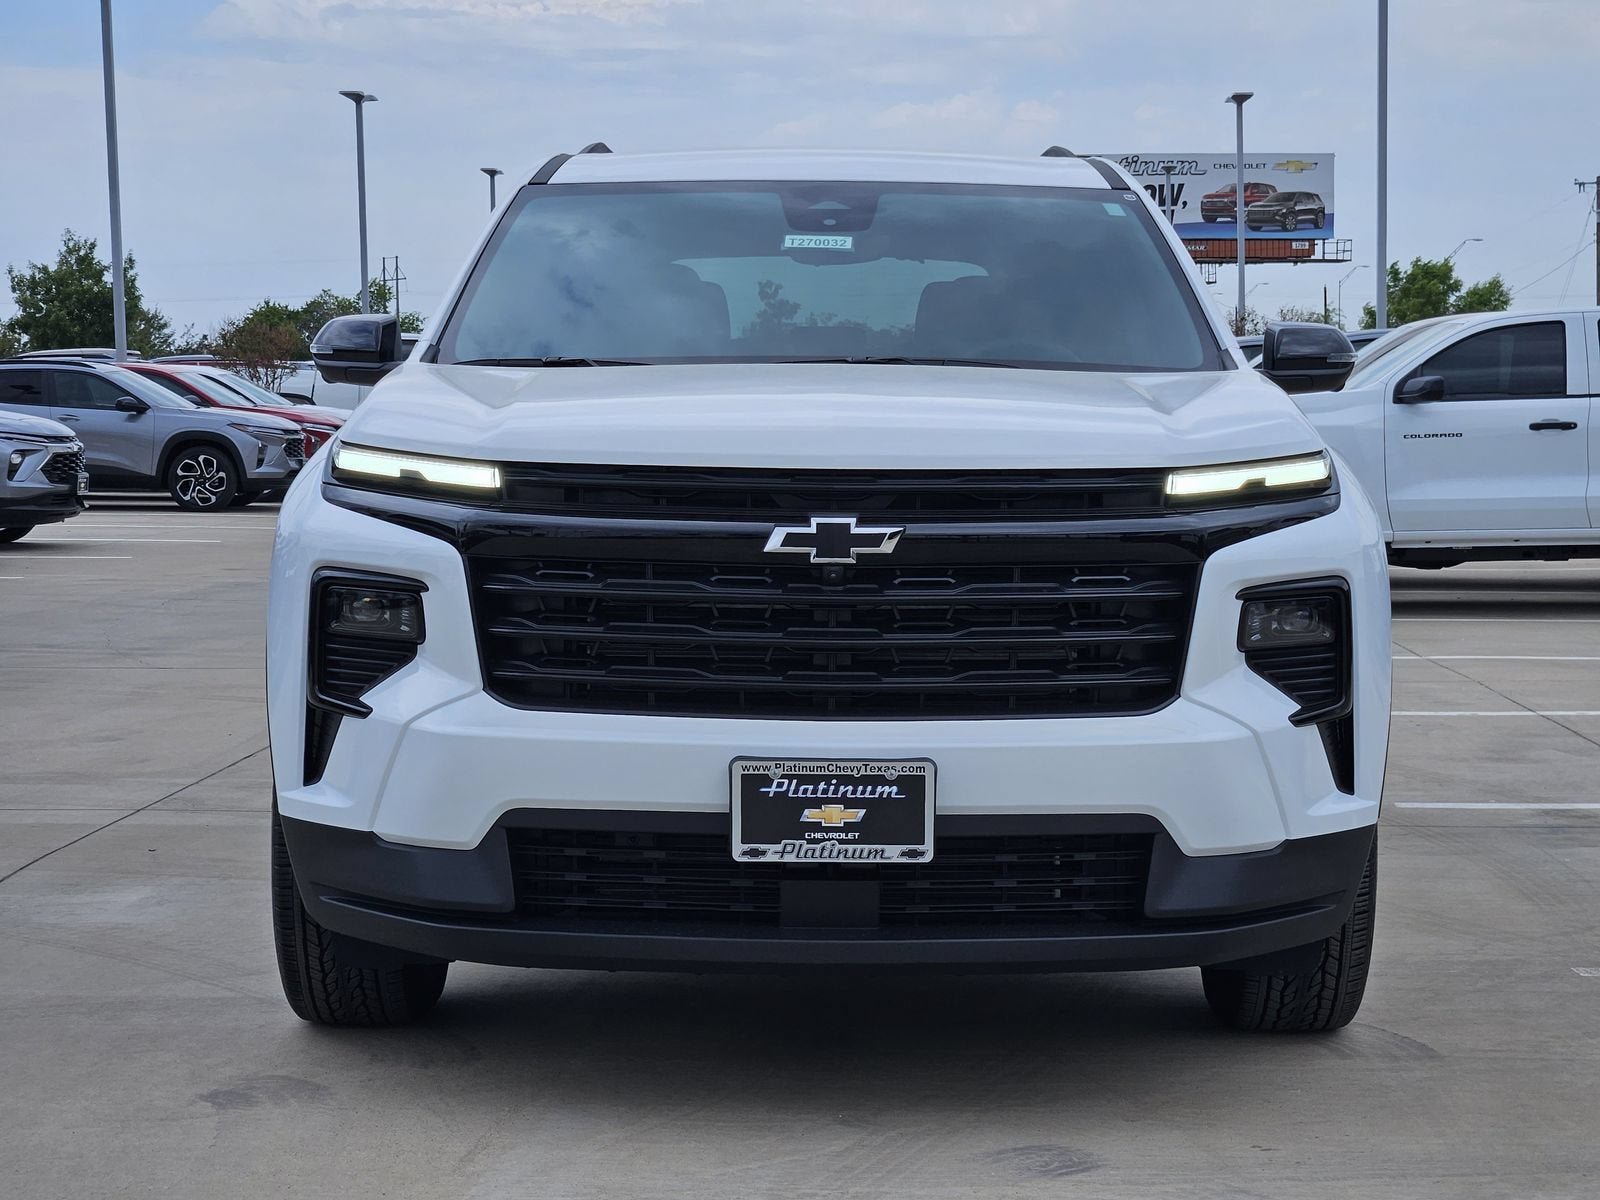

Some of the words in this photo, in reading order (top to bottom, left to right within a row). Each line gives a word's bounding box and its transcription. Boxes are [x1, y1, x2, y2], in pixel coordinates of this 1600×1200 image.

[1116, 155, 1207, 176] tinum
[1213, 162, 1267, 170] CHEVOLET
[789, 238, 848, 247] T270032
[1403, 432, 1463, 440] COLORADO
[741, 762, 926, 776] www.PlatinumChevyTexas.com
[759, 779, 906, 798] Platinum
[804, 832, 860, 840] CHEVROLET
[771, 842, 893, 860] Platinum
